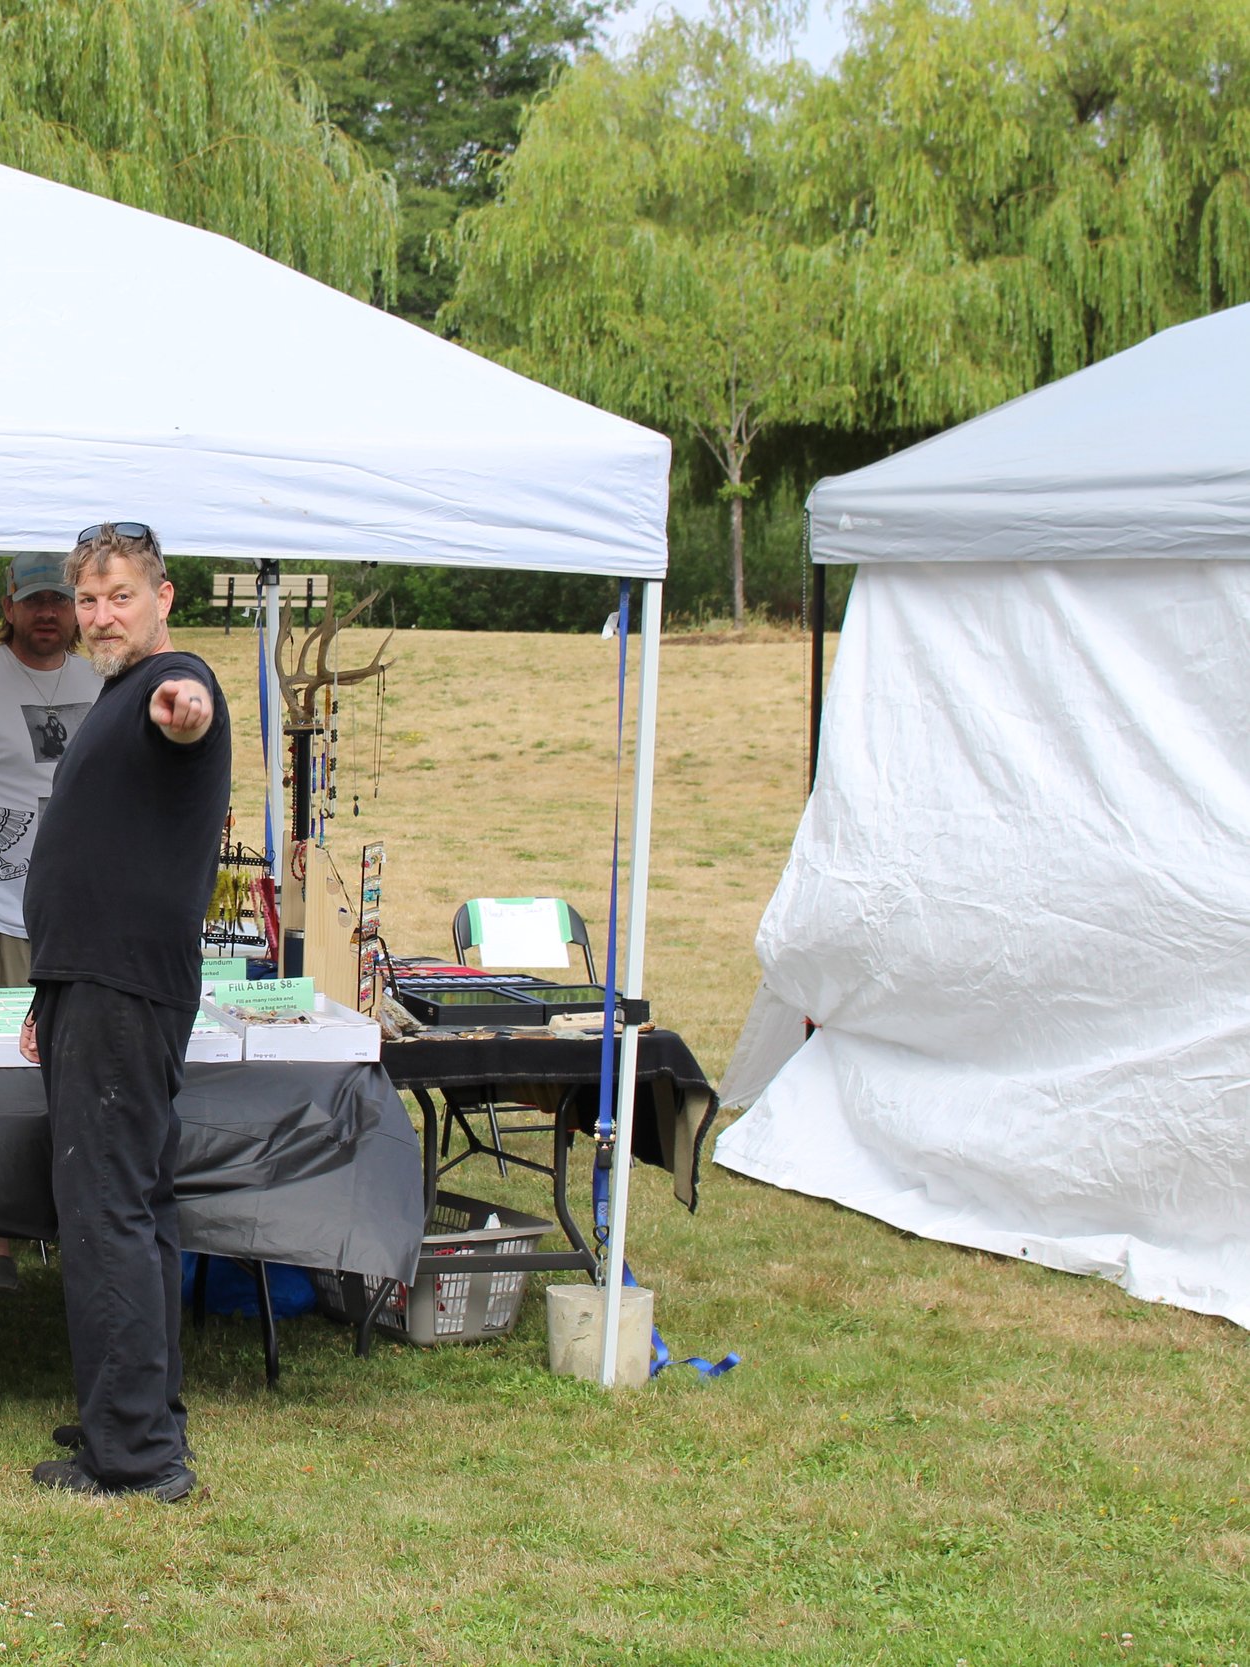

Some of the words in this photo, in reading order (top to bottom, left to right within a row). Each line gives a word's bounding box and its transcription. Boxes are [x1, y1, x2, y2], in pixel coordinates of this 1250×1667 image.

[228, 983, 245, 991] Fill
[247, 983, 254, 991] A
[256, 981, 276, 991] Bag
